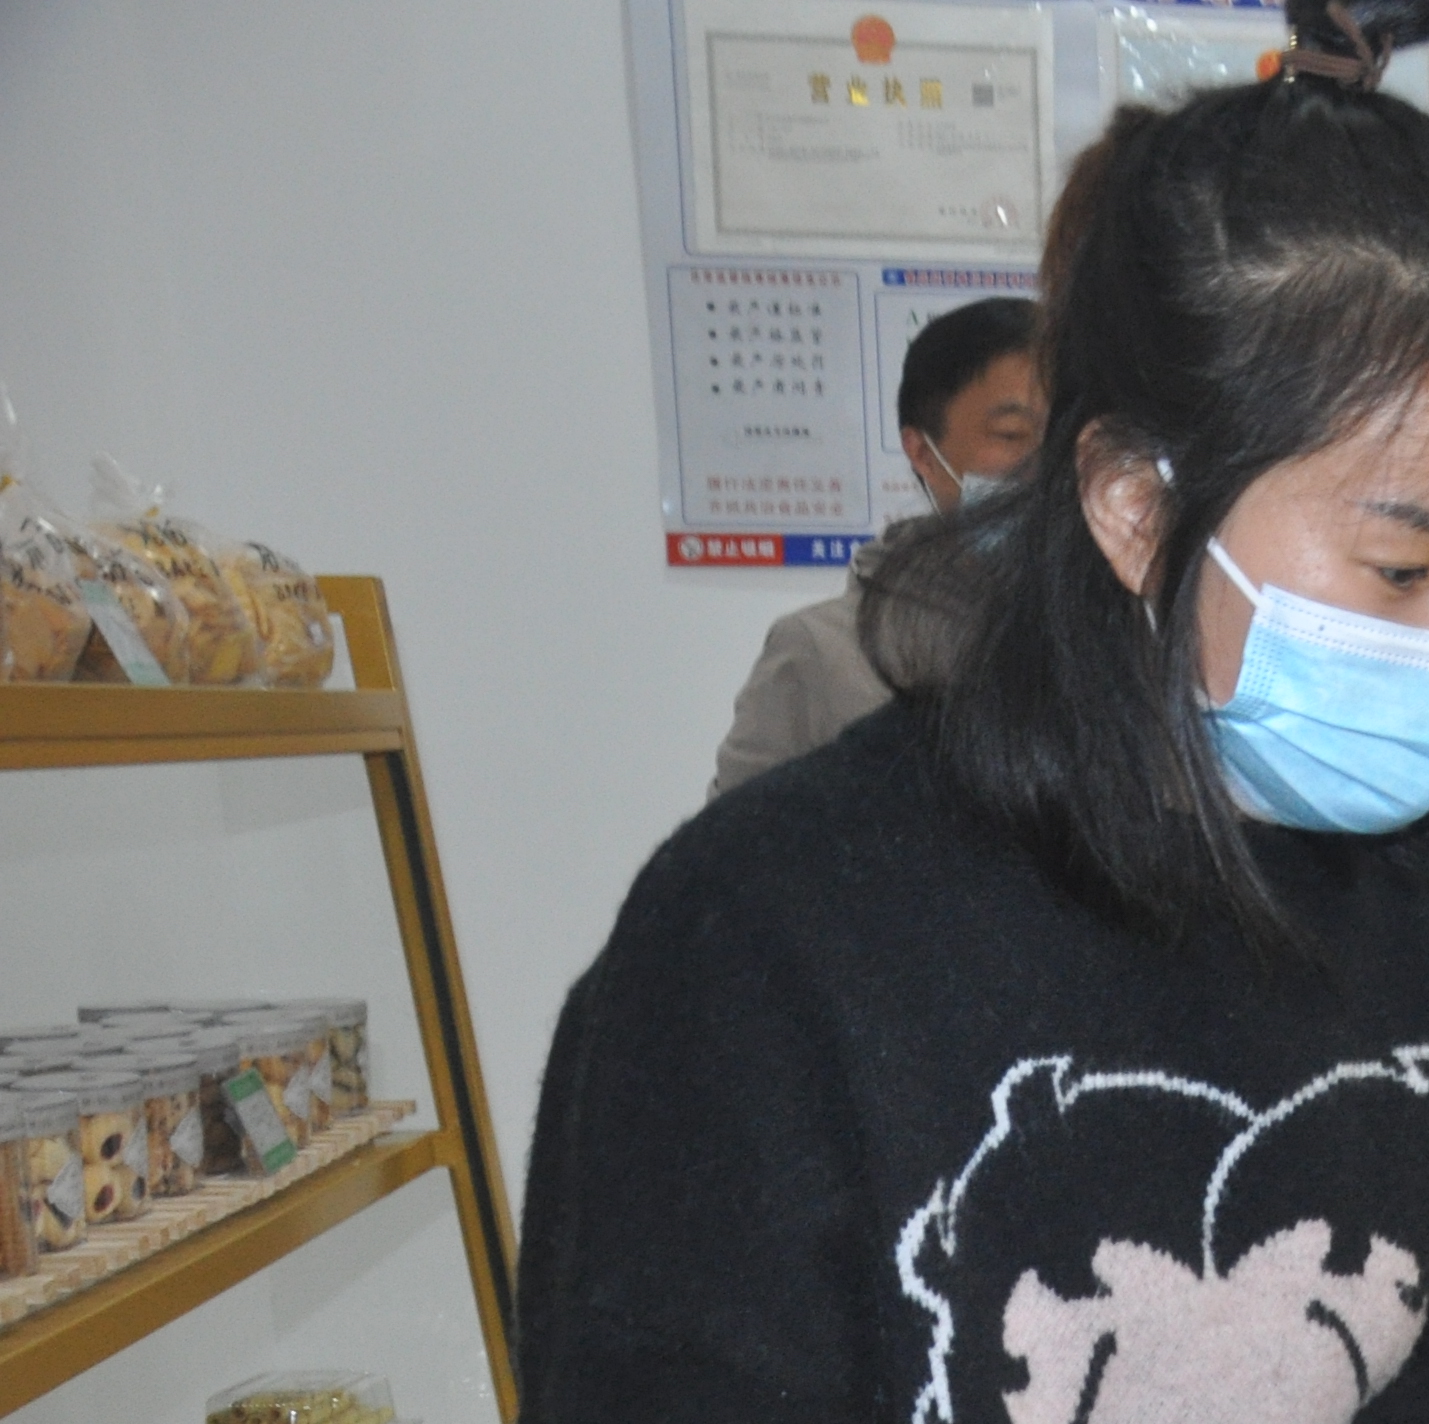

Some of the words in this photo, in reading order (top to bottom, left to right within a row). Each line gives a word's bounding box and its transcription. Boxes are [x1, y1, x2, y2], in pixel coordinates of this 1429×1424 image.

[808, 70, 944, 109] 营业执照
[706, 538, 776, 559] 禁止吸烟
